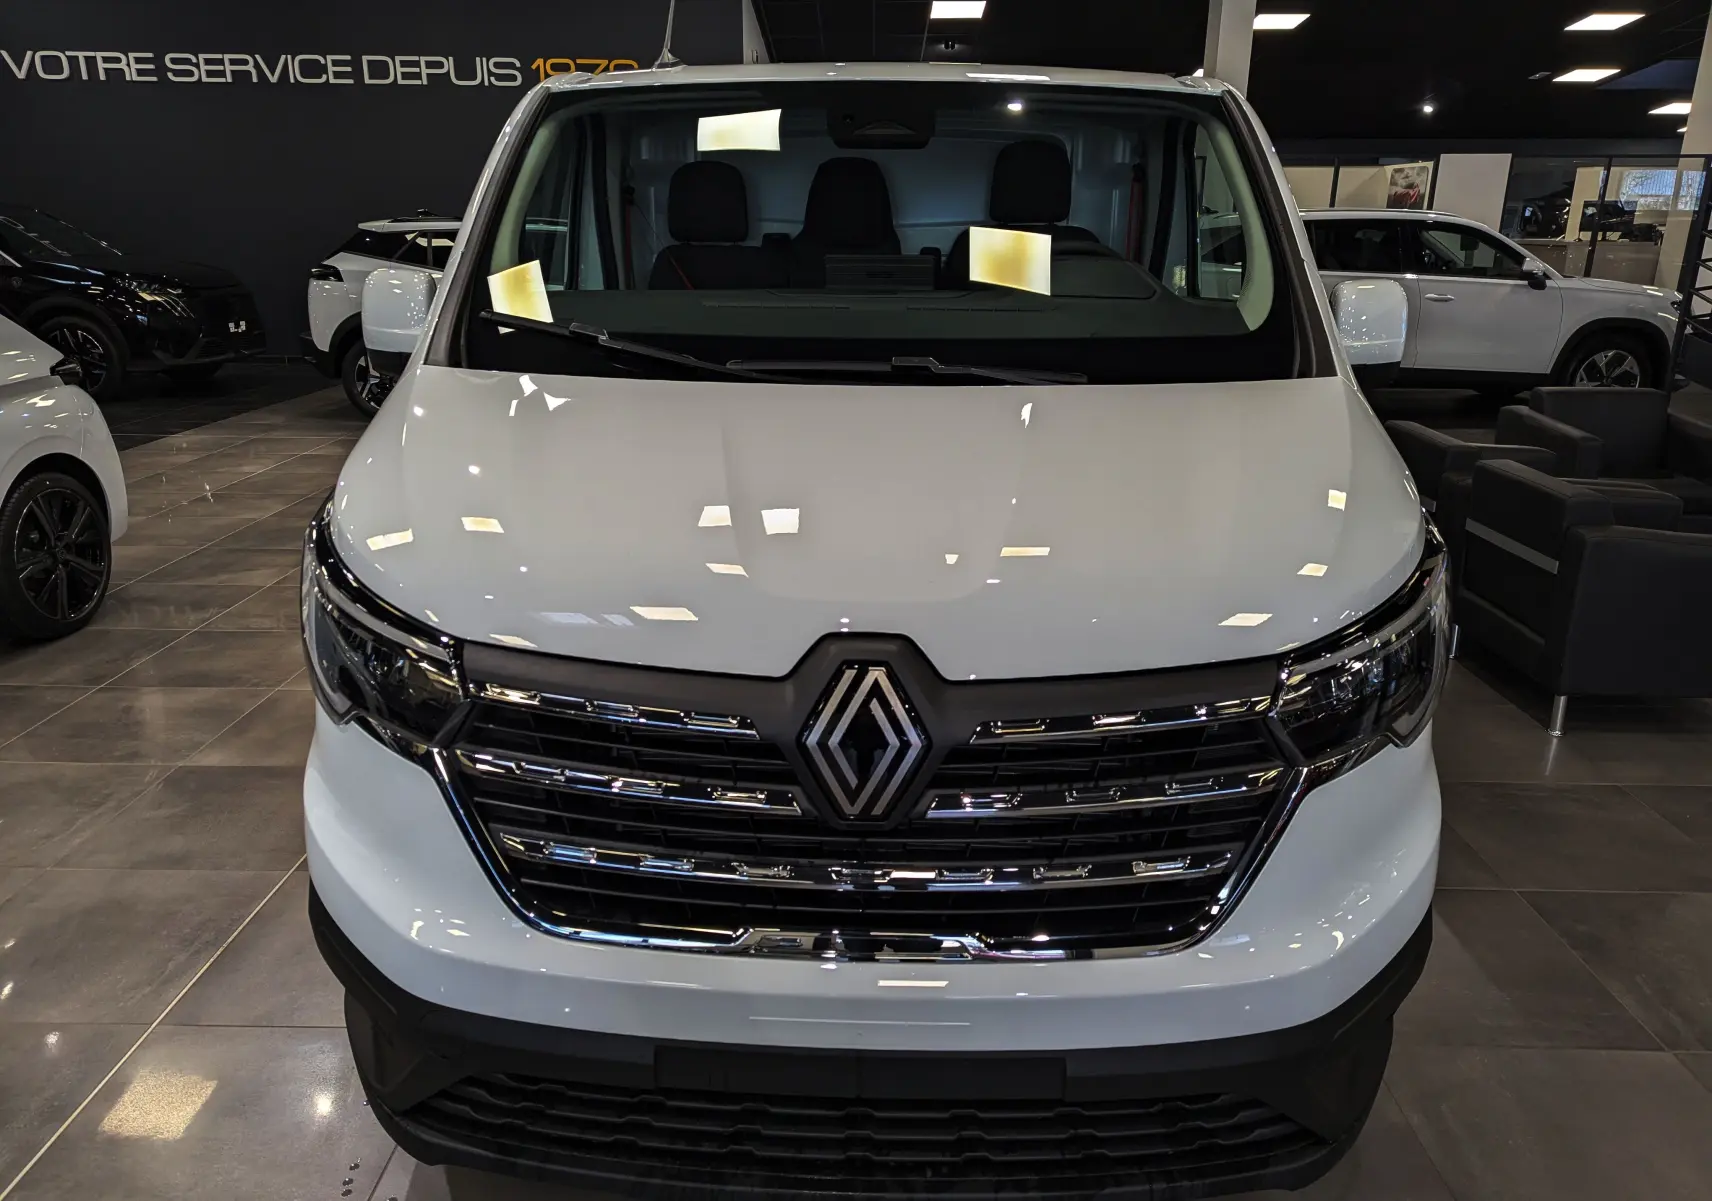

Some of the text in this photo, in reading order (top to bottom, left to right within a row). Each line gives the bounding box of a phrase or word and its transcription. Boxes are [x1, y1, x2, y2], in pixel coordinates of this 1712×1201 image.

[1, 50, 158, 82] VOTRE
[164, 52, 355, 84] SERVICE
[361, 55, 523, 87] DEPUIS
